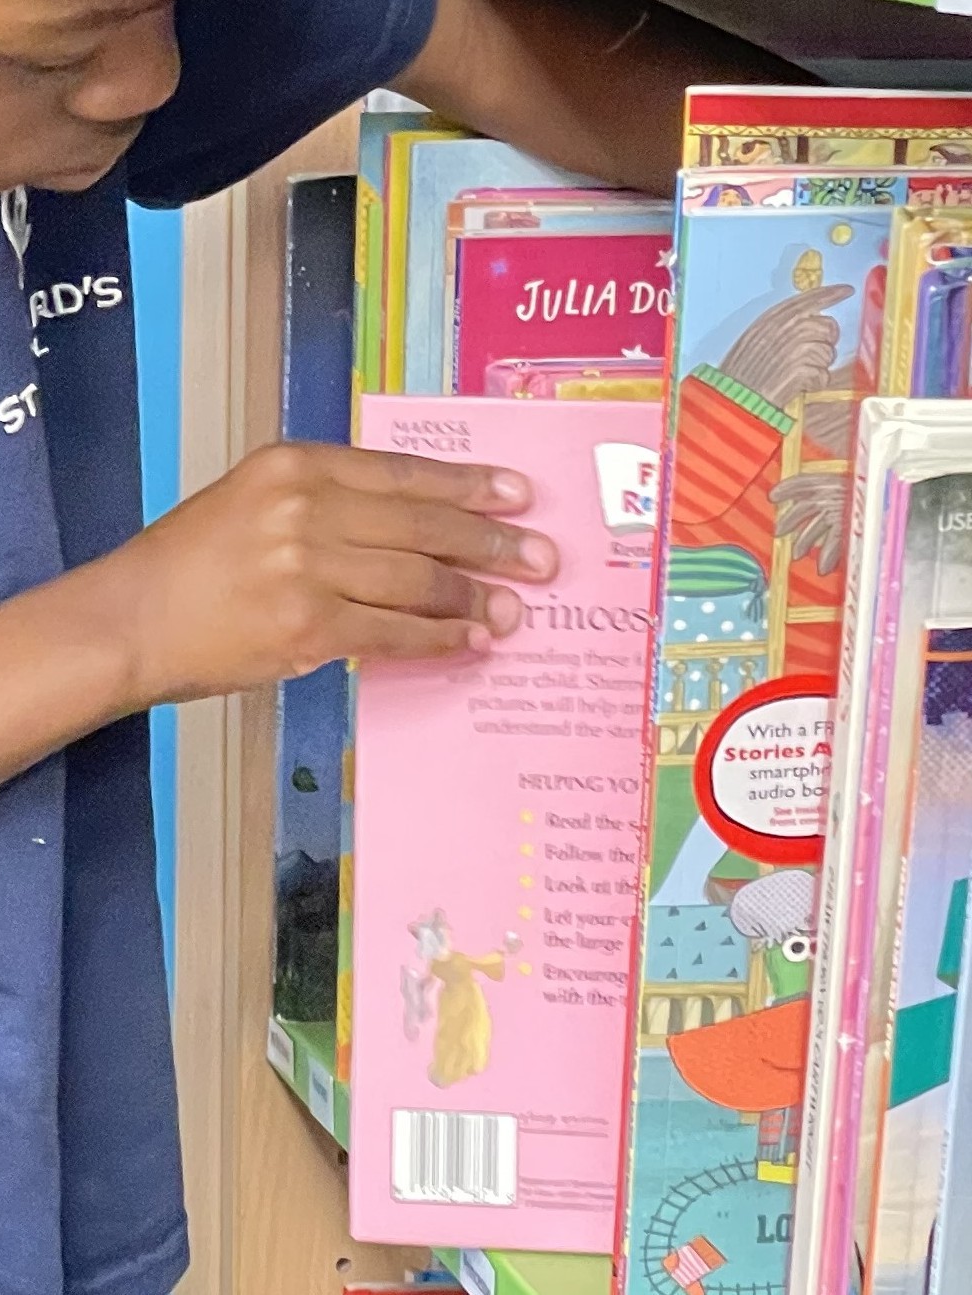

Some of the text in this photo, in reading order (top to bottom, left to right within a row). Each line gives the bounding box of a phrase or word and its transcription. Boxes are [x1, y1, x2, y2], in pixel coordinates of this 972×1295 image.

[515, 278, 616, 322] JULIA
[522, 593, 653, 633] rinces
[747, 722, 792, 739] With
[797, 726, 807, 737] a
[724, 743, 806, 762] Stories
[748, 784, 796, 801] audio
